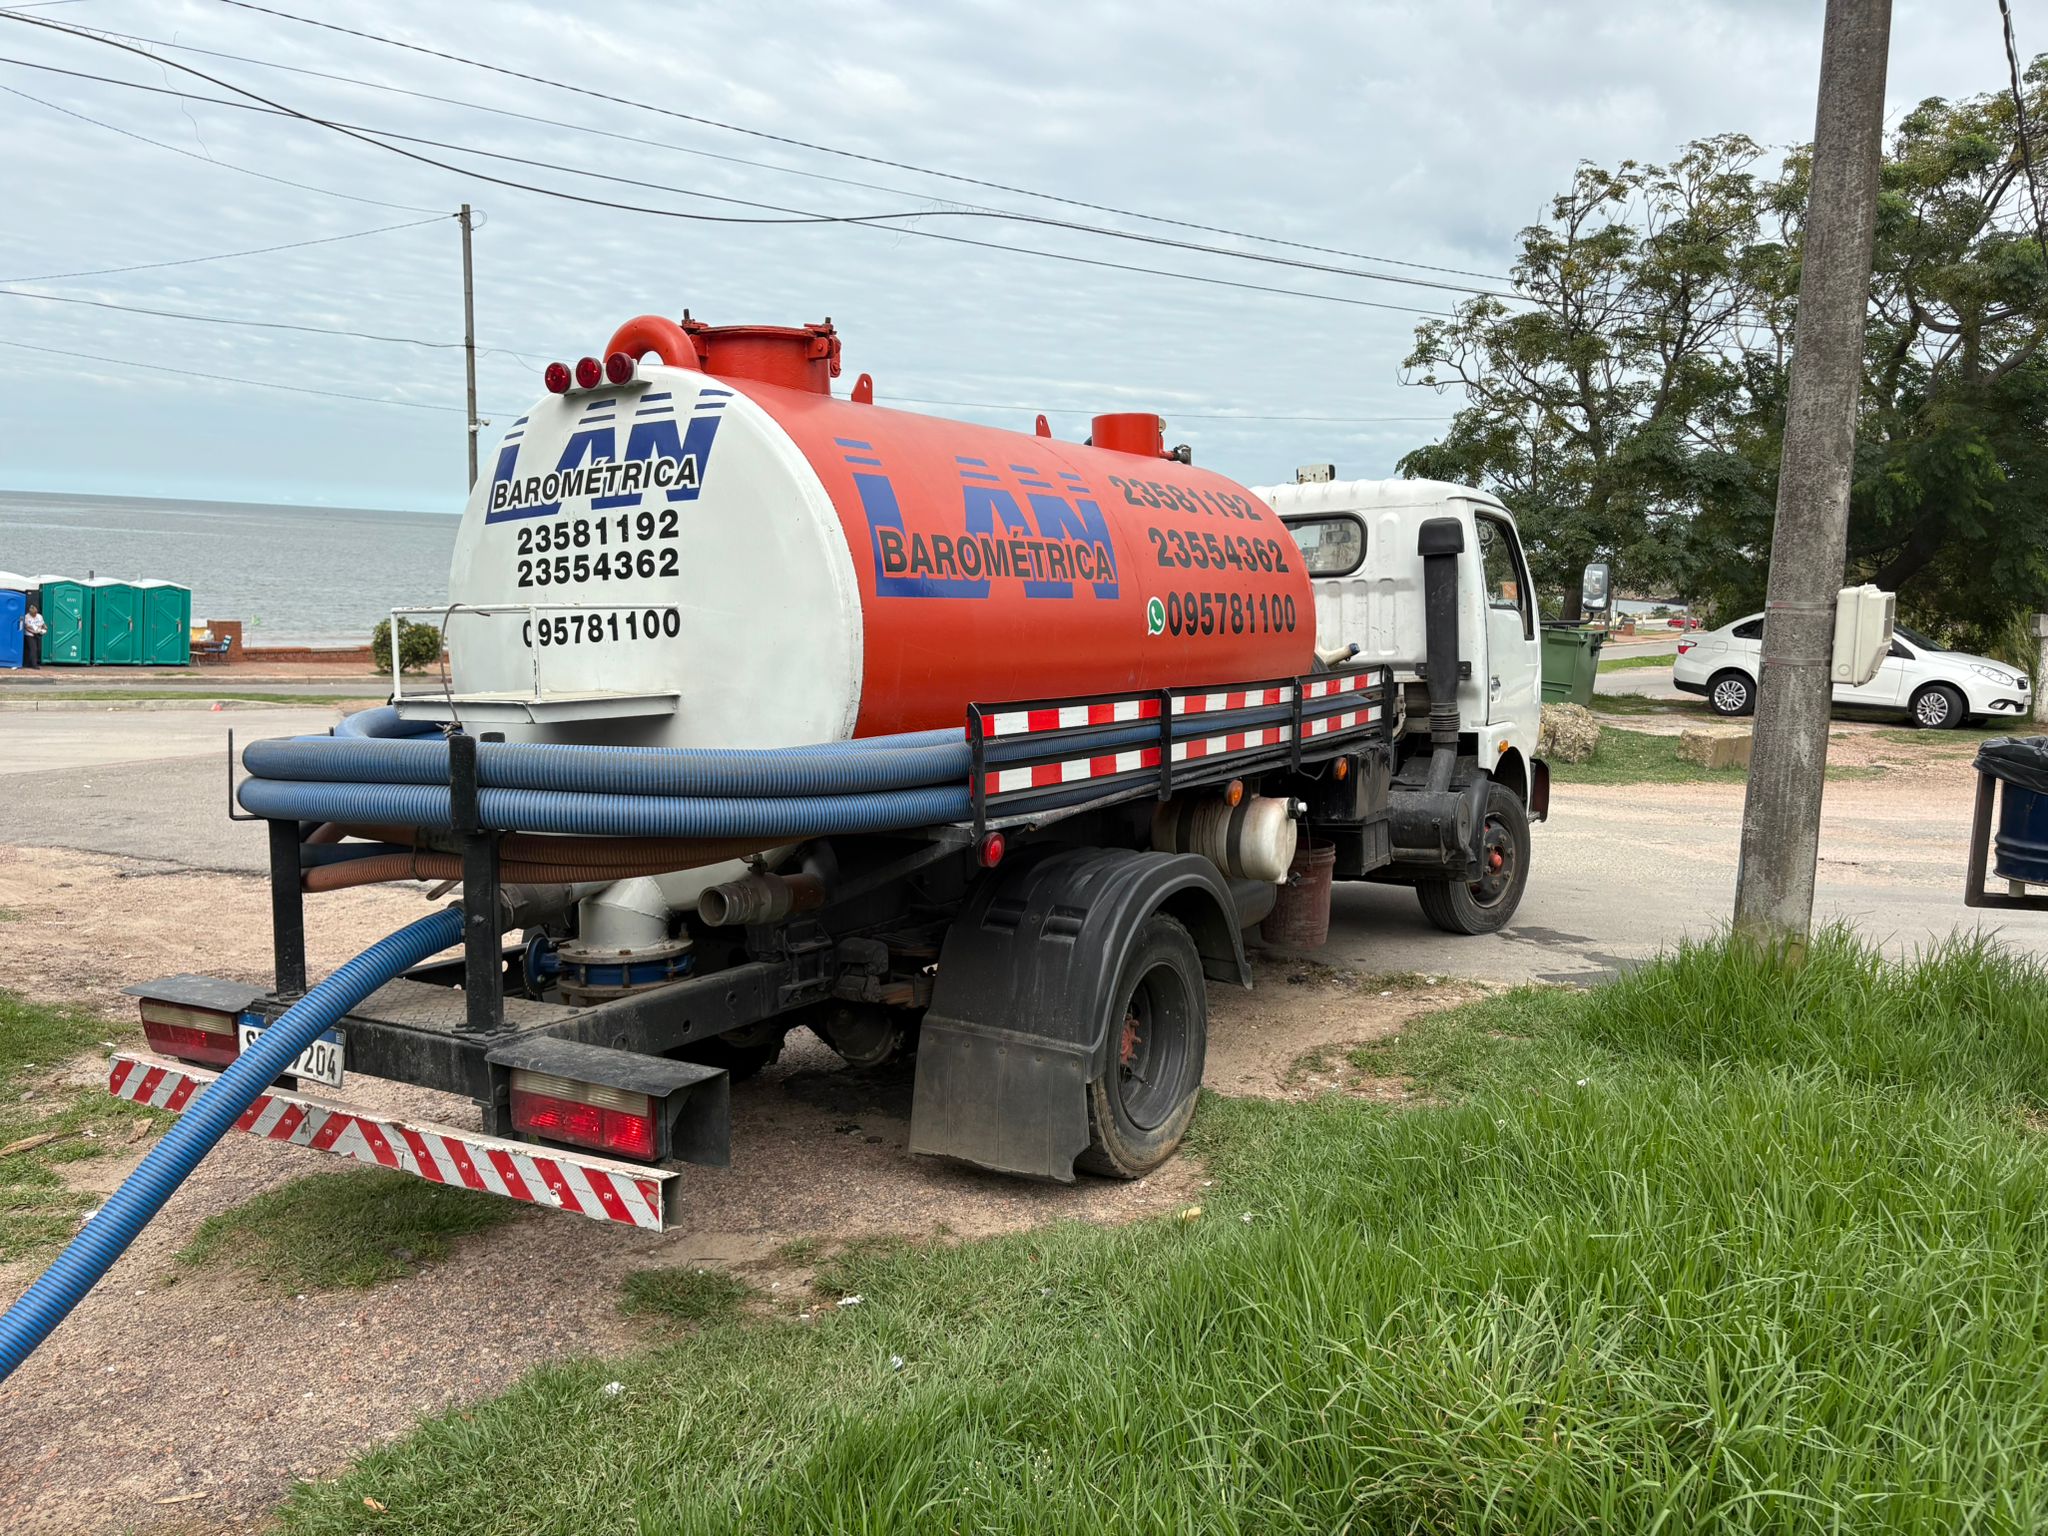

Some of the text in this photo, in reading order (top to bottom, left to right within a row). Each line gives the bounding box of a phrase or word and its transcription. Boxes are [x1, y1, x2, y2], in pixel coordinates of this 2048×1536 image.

[493, 457, 697, 510] BAROMÉTRICA
[1107, 474, 1263, 521] 23581192
[517, 509, 680, 556] 23581192
[879, 530, 1113, 582] BAROMÉTRICA
[1147, 526, 1289, 574] 23554362
[517, 547, 680, 588] 23554362
[1168, 592, 1296, 637] 095781100
